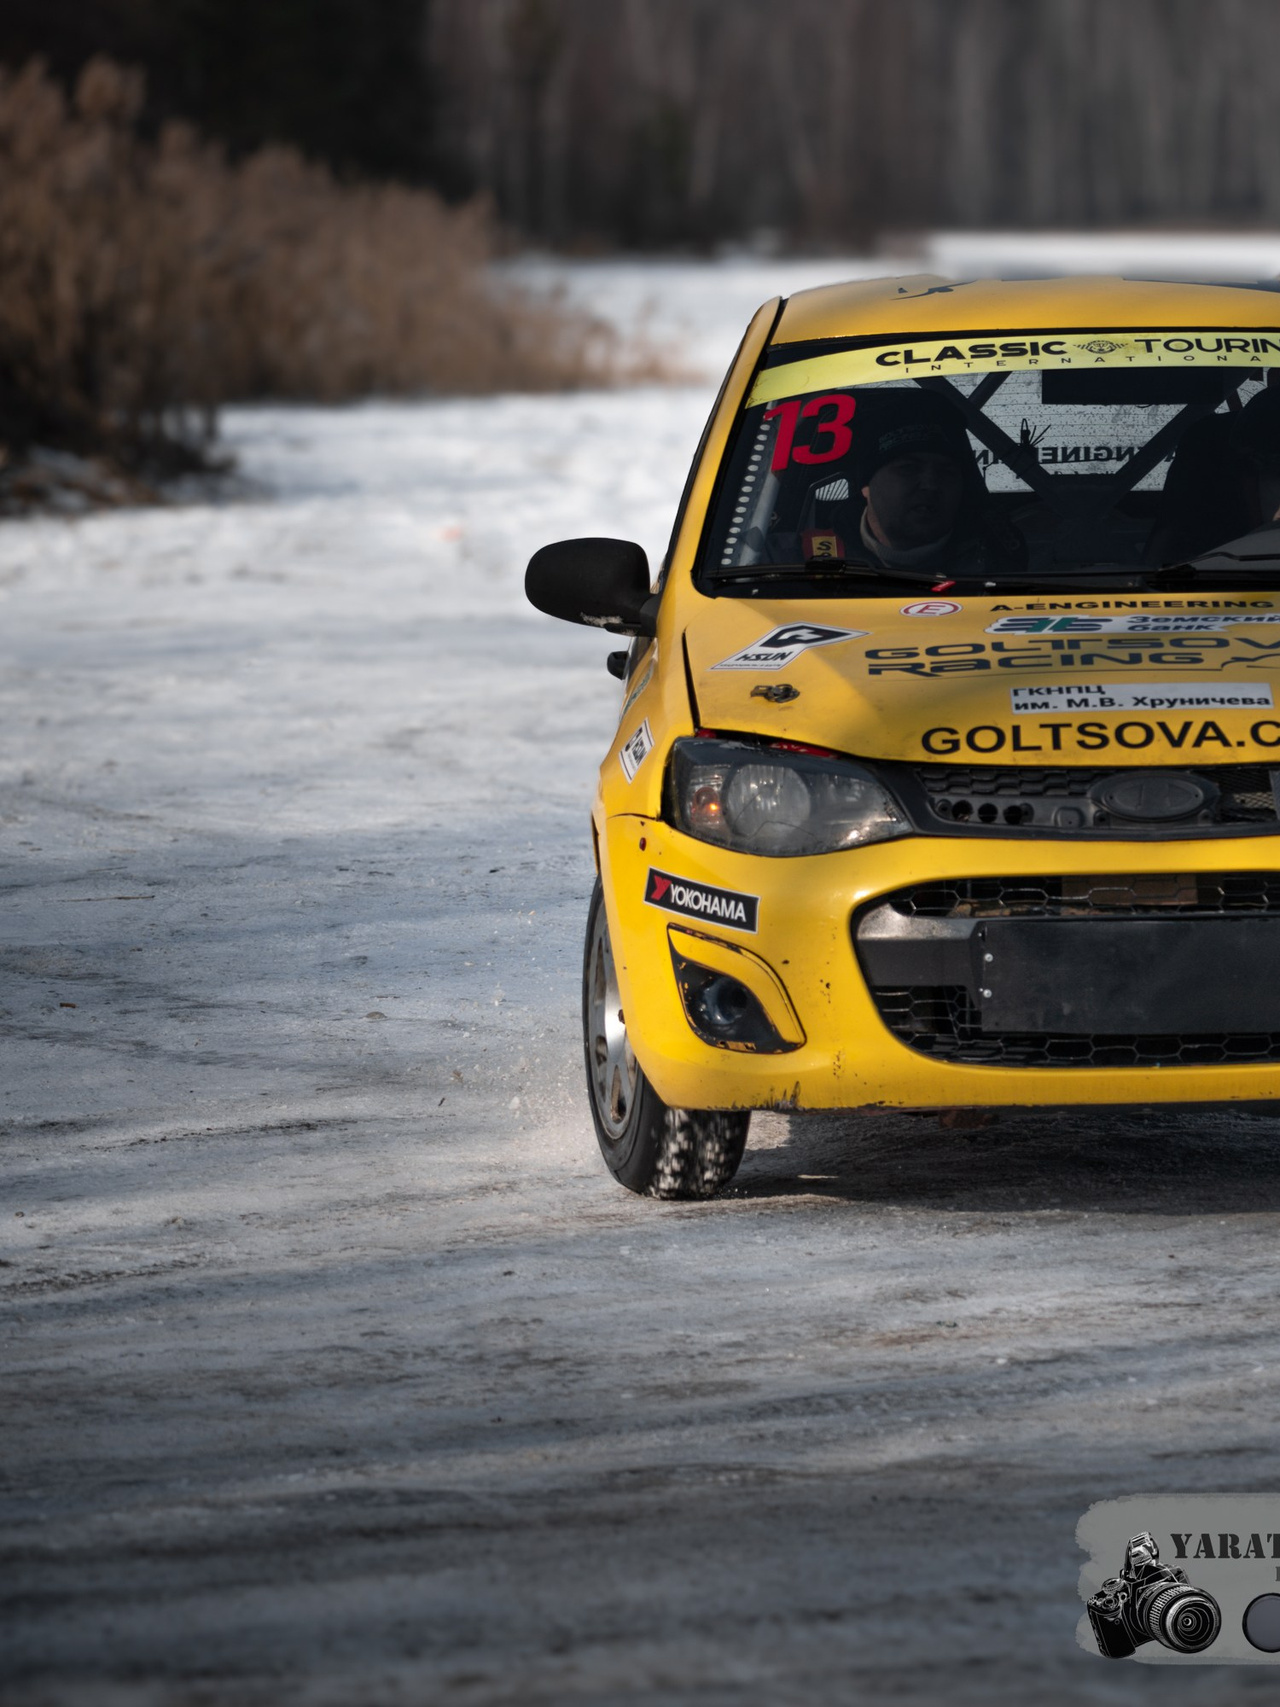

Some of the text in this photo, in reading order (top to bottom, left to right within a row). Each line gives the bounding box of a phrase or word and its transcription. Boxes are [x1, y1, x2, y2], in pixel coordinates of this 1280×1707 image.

[875, 341, 1068, 366] CLASSIC
[763, 394, 856, 471] 13
[990, 601, 1275, 612] A-ENGINEERING
[1127, 623, 1216, 632] банк
[1012, 685, 1106, 697] ГКНПЦ
[1132, 696, 1271, 709] Хруничева
[670, 883, 747, 923] YOKOHAMA
